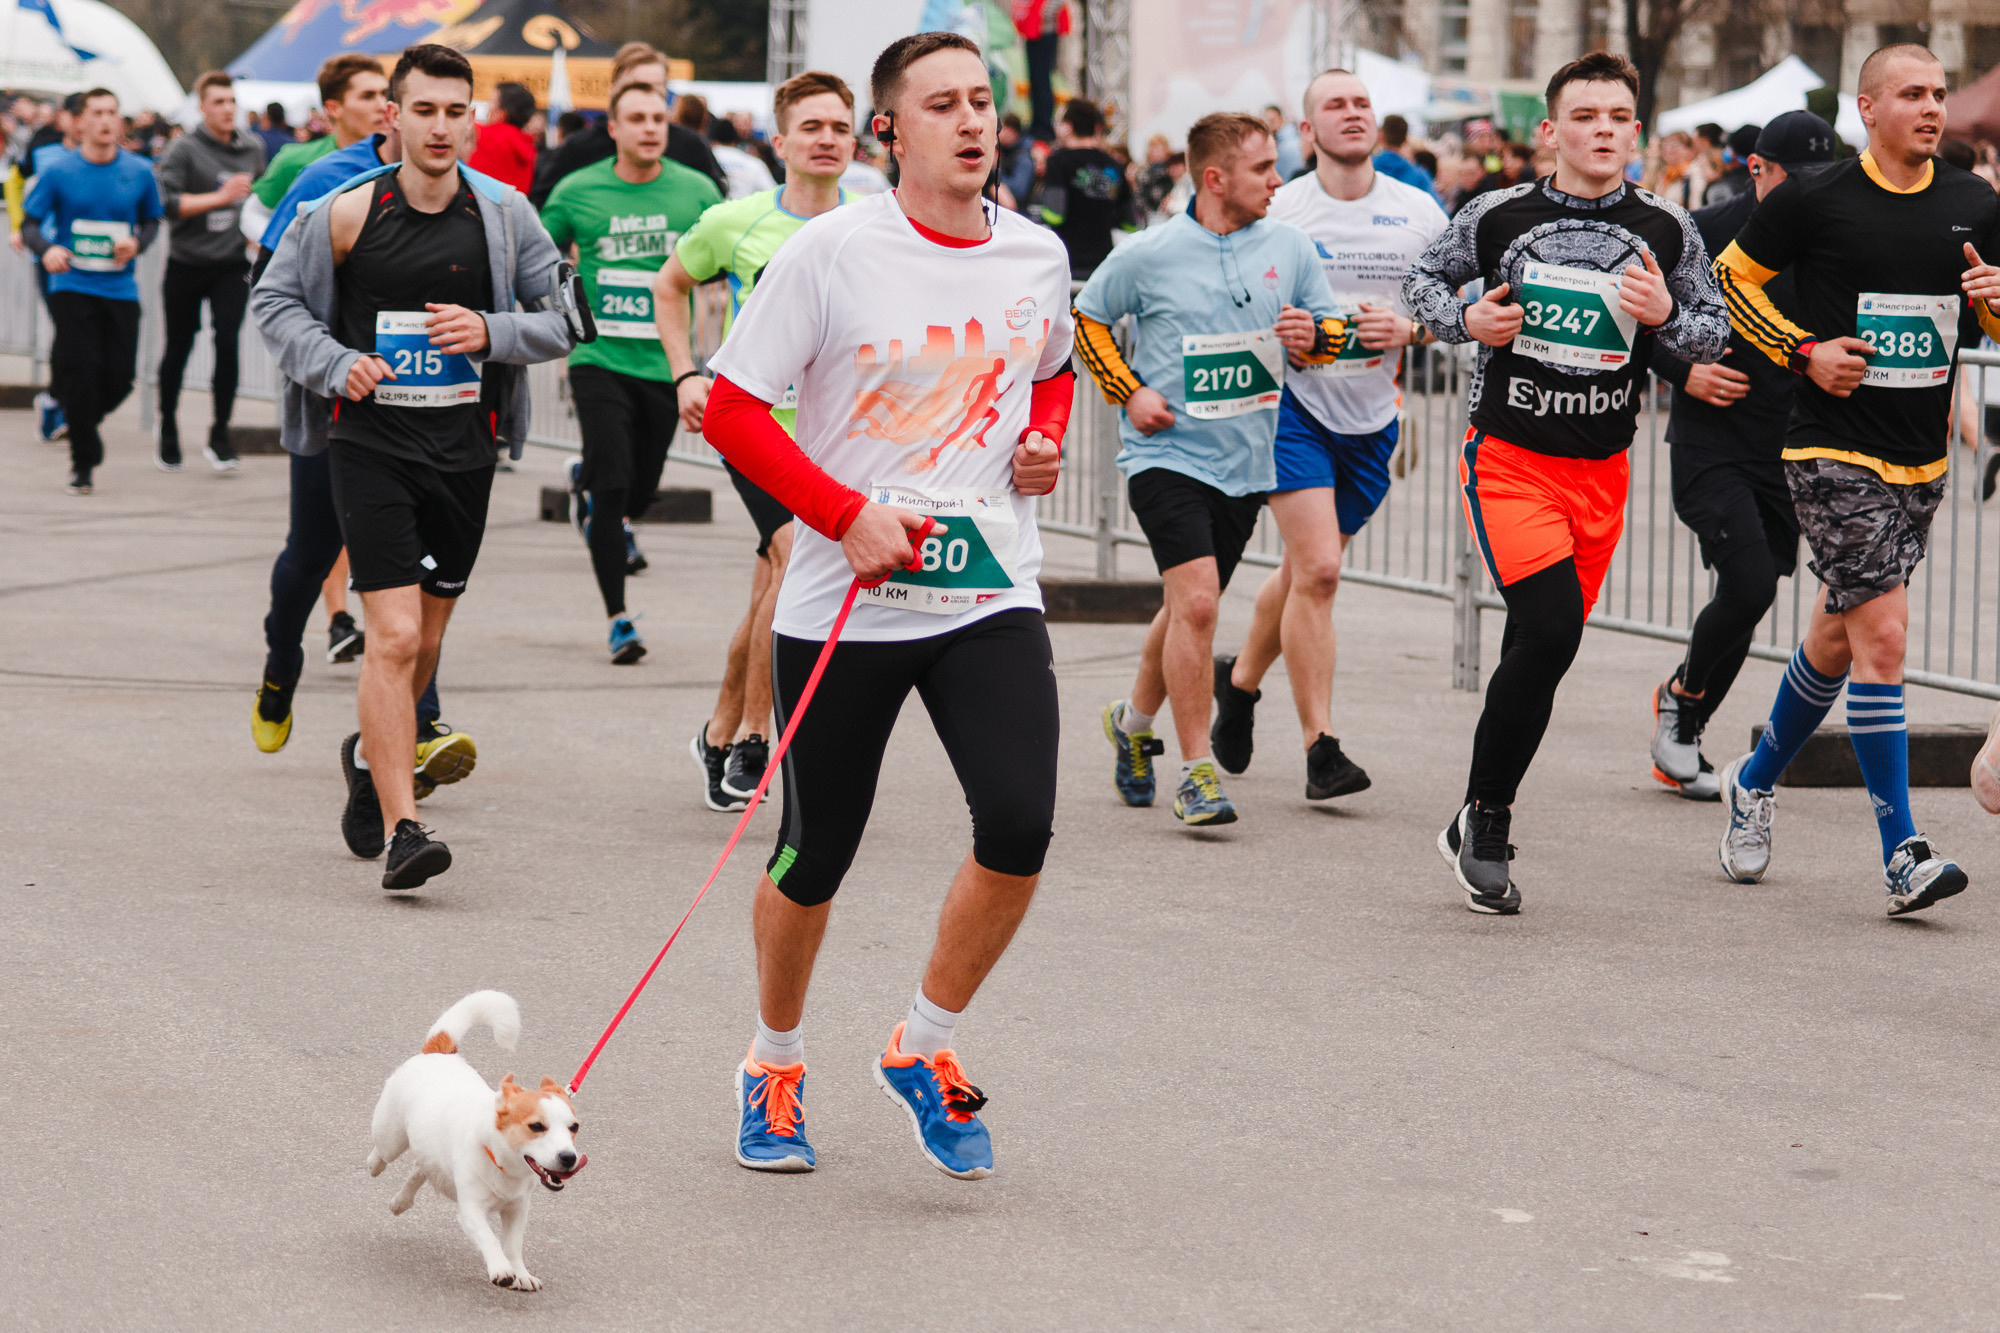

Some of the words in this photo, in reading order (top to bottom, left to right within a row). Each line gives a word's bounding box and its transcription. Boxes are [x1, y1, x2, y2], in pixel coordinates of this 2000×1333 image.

[612, 235, 666, 255] TEAM
[1543, 272, 1596, 287] Жилстрой-1
[602, 293, 650, 317] 2143
[1005, 309, 1038, 318] BEKEY
[1876, 303, 1927, 311] Жилстрой-1
[1524, 300, 1601, 336] 3247
[1520, 339, 1531, 349] 10
[1861, 330, 1932, 357] 2383
[394, 349, 443, 375] 215
[1193, 365, 1252, 392] 2170
[379, 392, 409, 401] 42,195
[1507, 376, 1632, 417] Symbol
[896, 495, 964, 510] Жилстрой-1
[919, 537, 969, 572] 80
